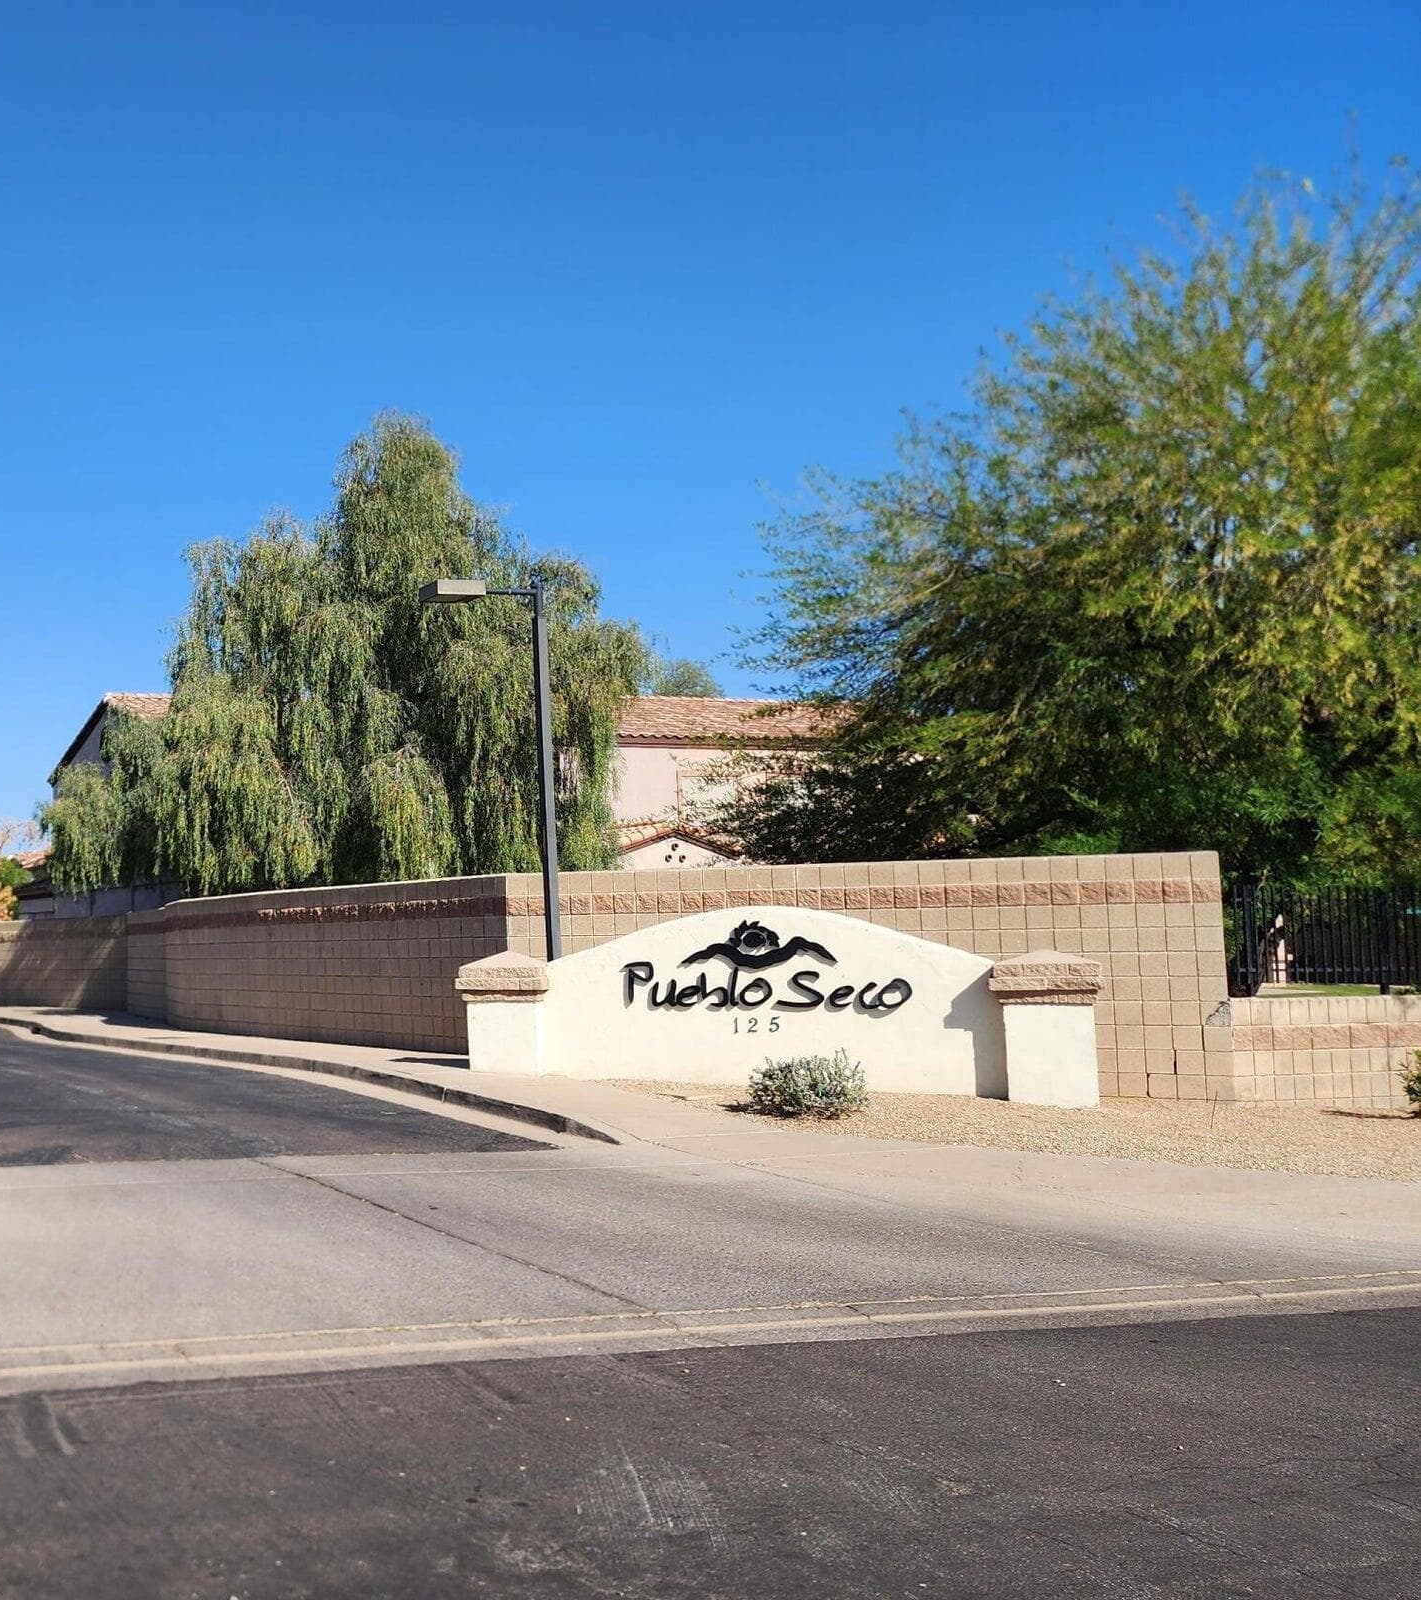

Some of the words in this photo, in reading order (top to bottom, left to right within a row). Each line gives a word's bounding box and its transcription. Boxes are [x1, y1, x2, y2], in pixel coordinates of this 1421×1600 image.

[625, 961, 773, 1008] Pueblo
[776, 971, 912, 1010] Seco
[732, 1016, 781, 1034] 125
